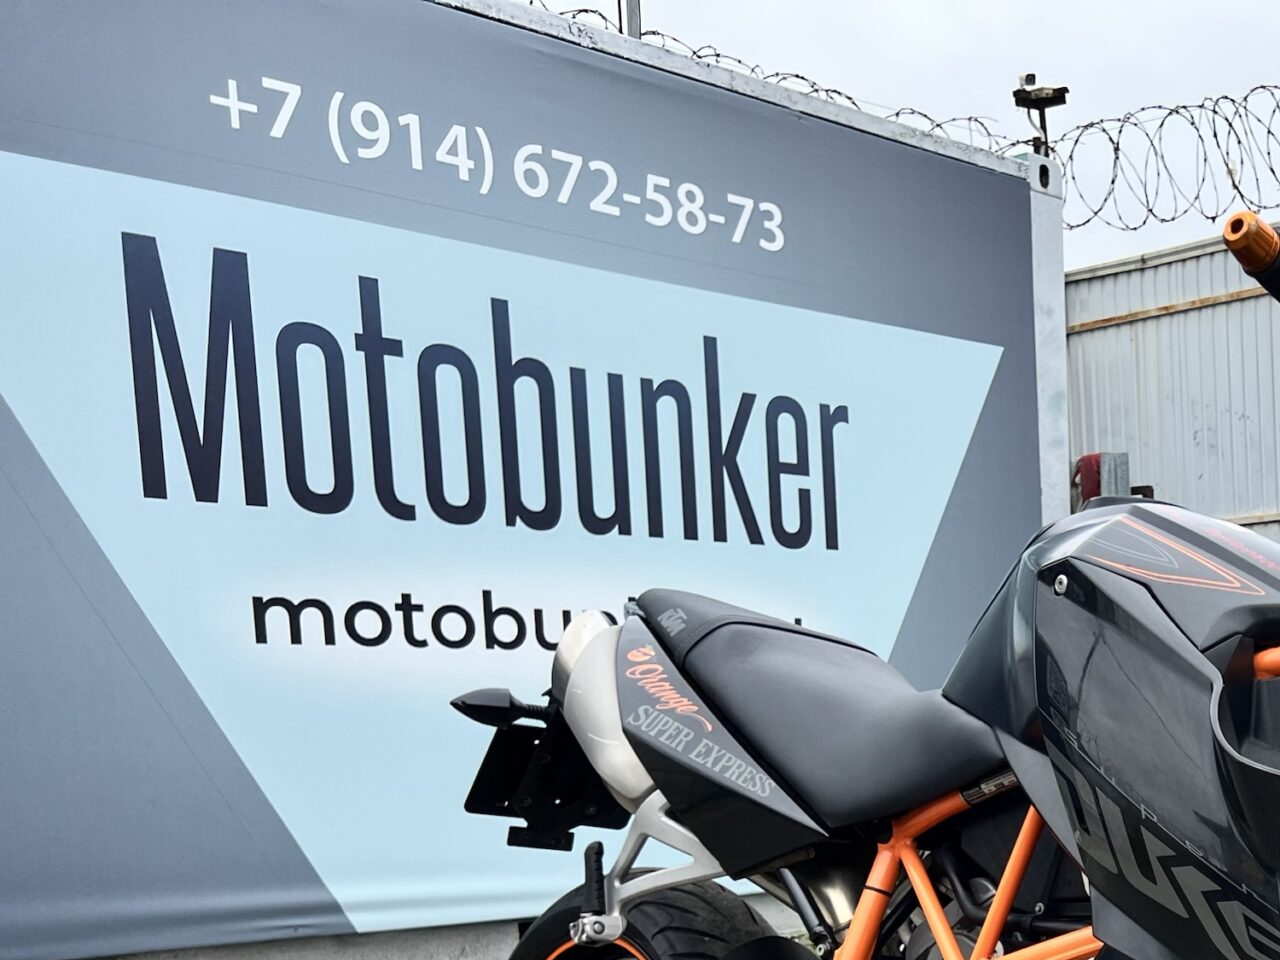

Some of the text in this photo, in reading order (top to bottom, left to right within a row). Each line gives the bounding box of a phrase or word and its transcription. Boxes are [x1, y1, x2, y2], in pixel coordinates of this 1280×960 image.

[209, 76, 786, 252] +7 (914) 672-58-73
[121, 231, 850, 551] Motobunker
[657, 607, 688, 637] KTM
[626, 663, 713, 732] Orange
[627, 704, 776, 797] SUPER EXPRESS
